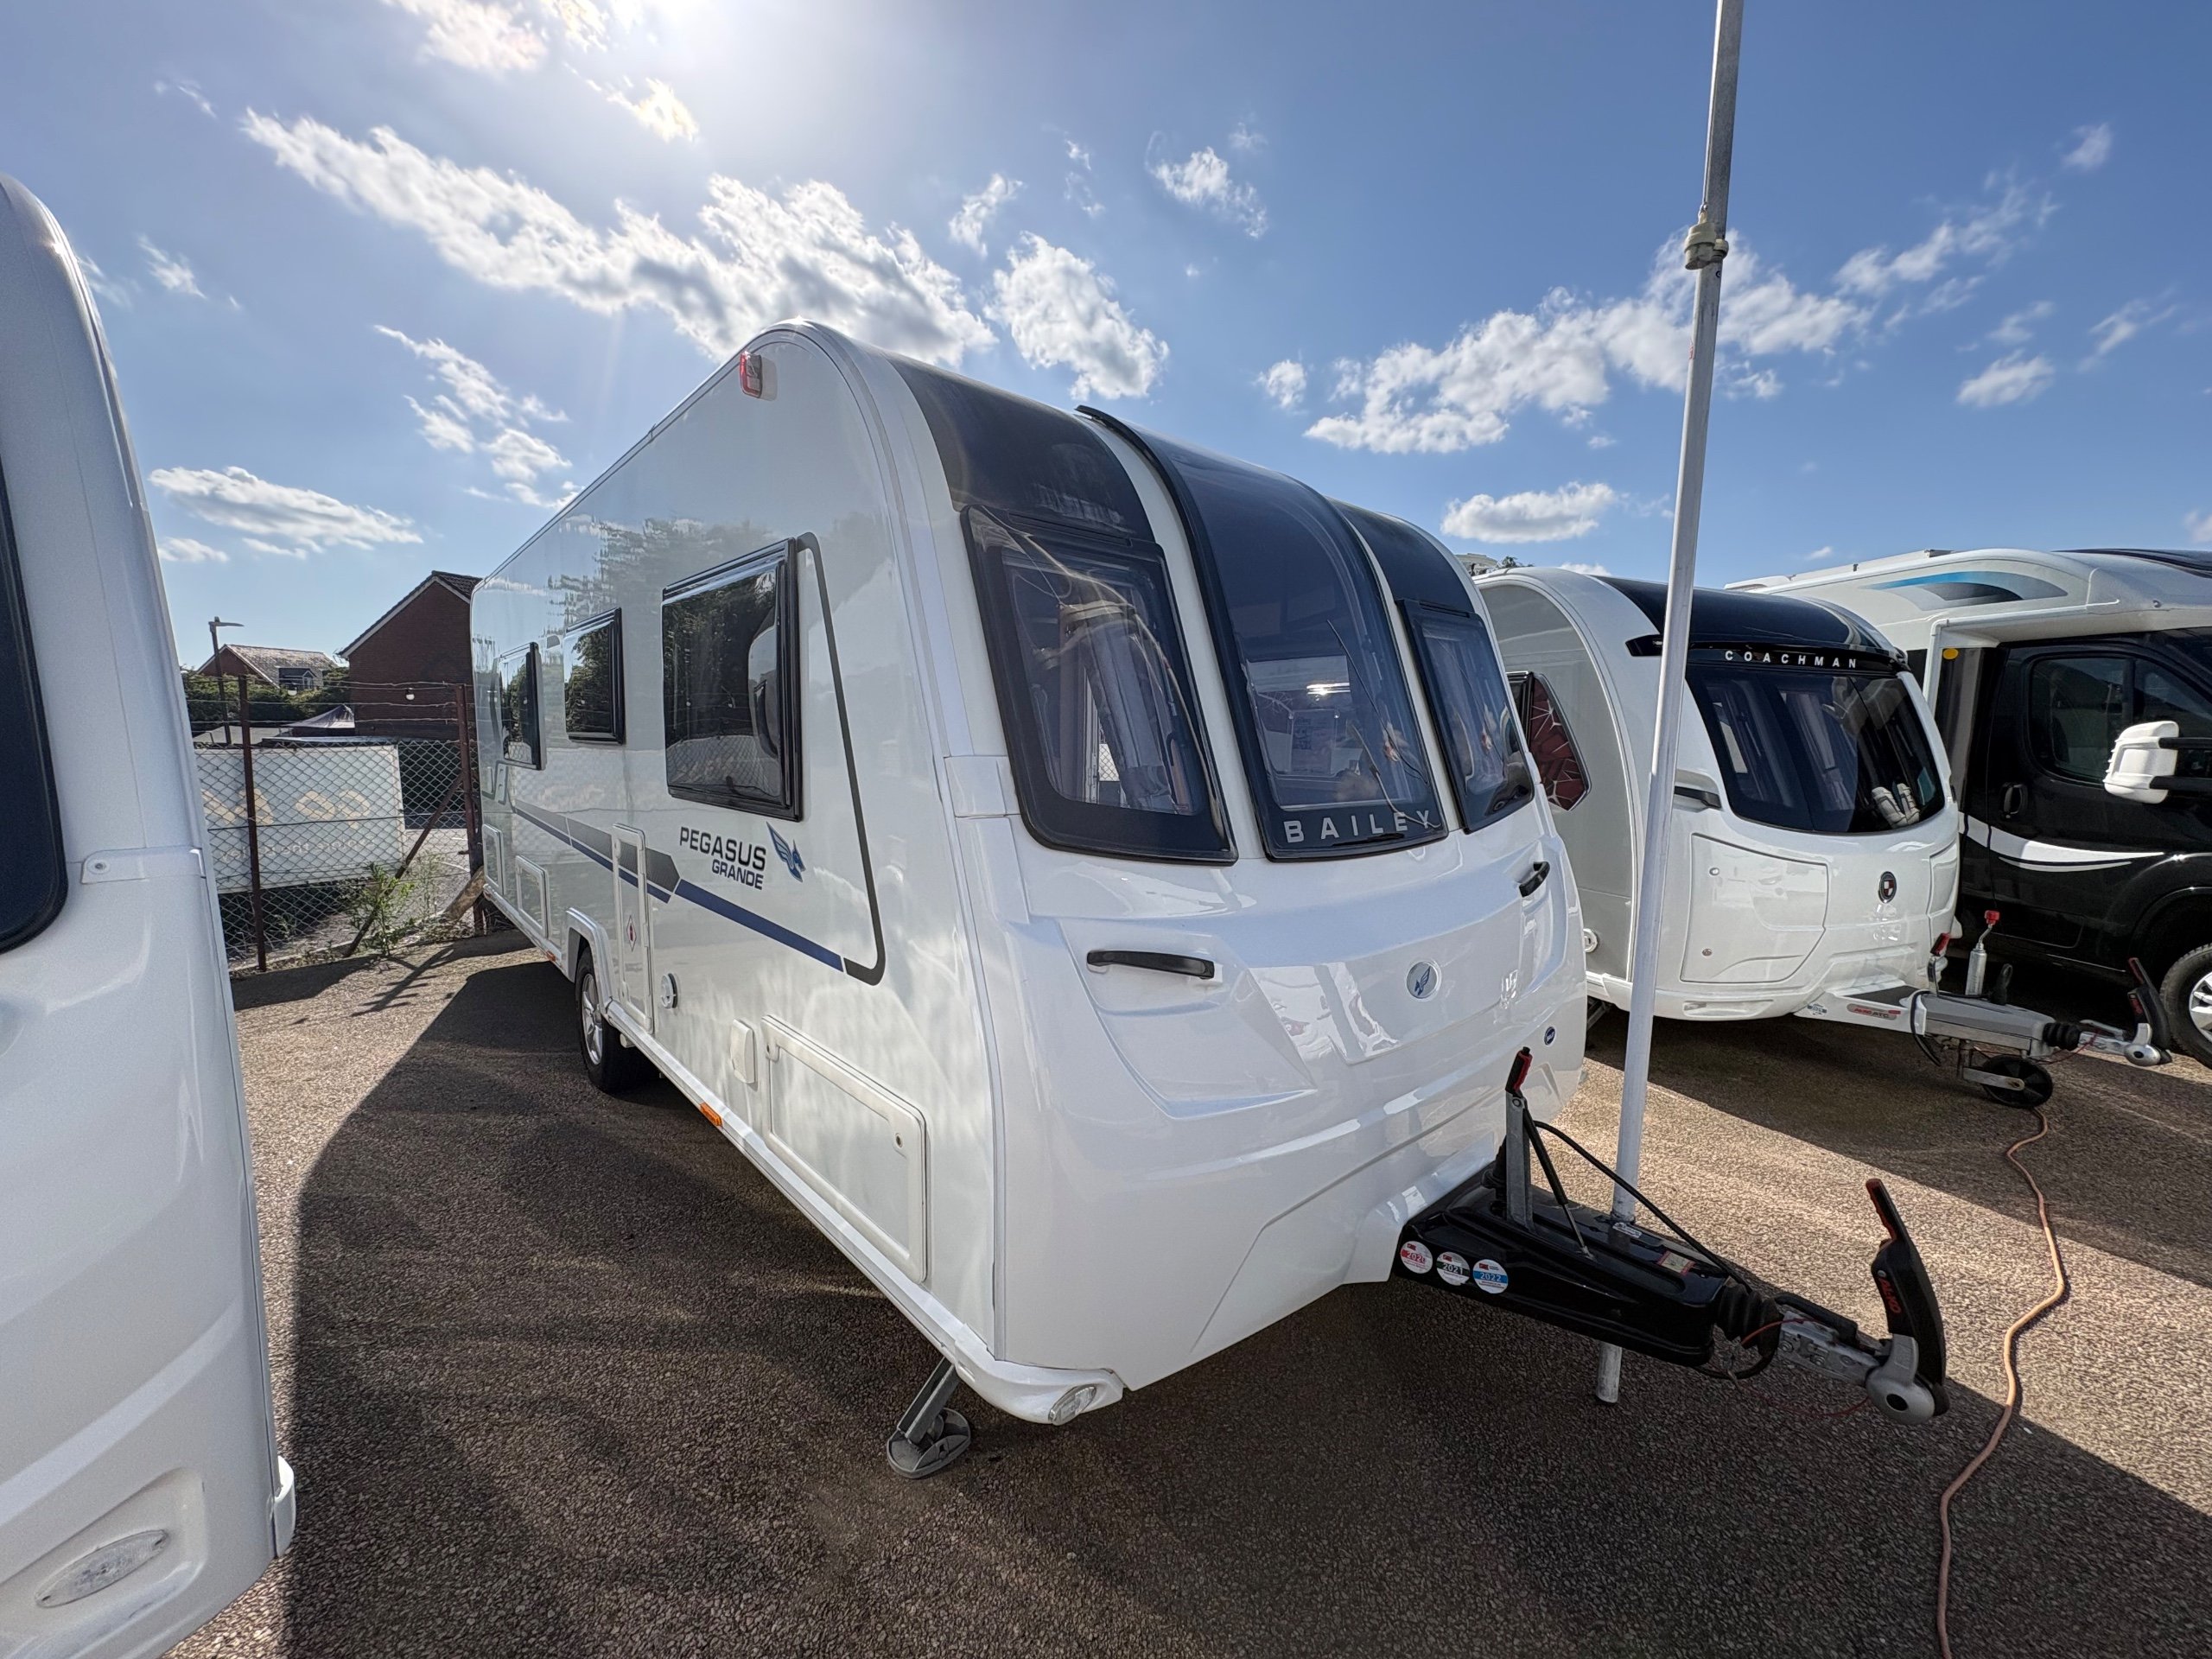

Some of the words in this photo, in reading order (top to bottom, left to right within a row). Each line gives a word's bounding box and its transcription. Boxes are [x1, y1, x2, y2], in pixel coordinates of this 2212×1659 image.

[1725, 651, 1856, 669] COACHMAN
[1283, 810, 1430, 843] BAILEY
[679, 827, 767, 871] PEGASUS
[711, 859, 764, 891] GRANDE
[1442, 1262, 1464, 1275] 2021
[1479, 1272, 1502, 1282] 2022
